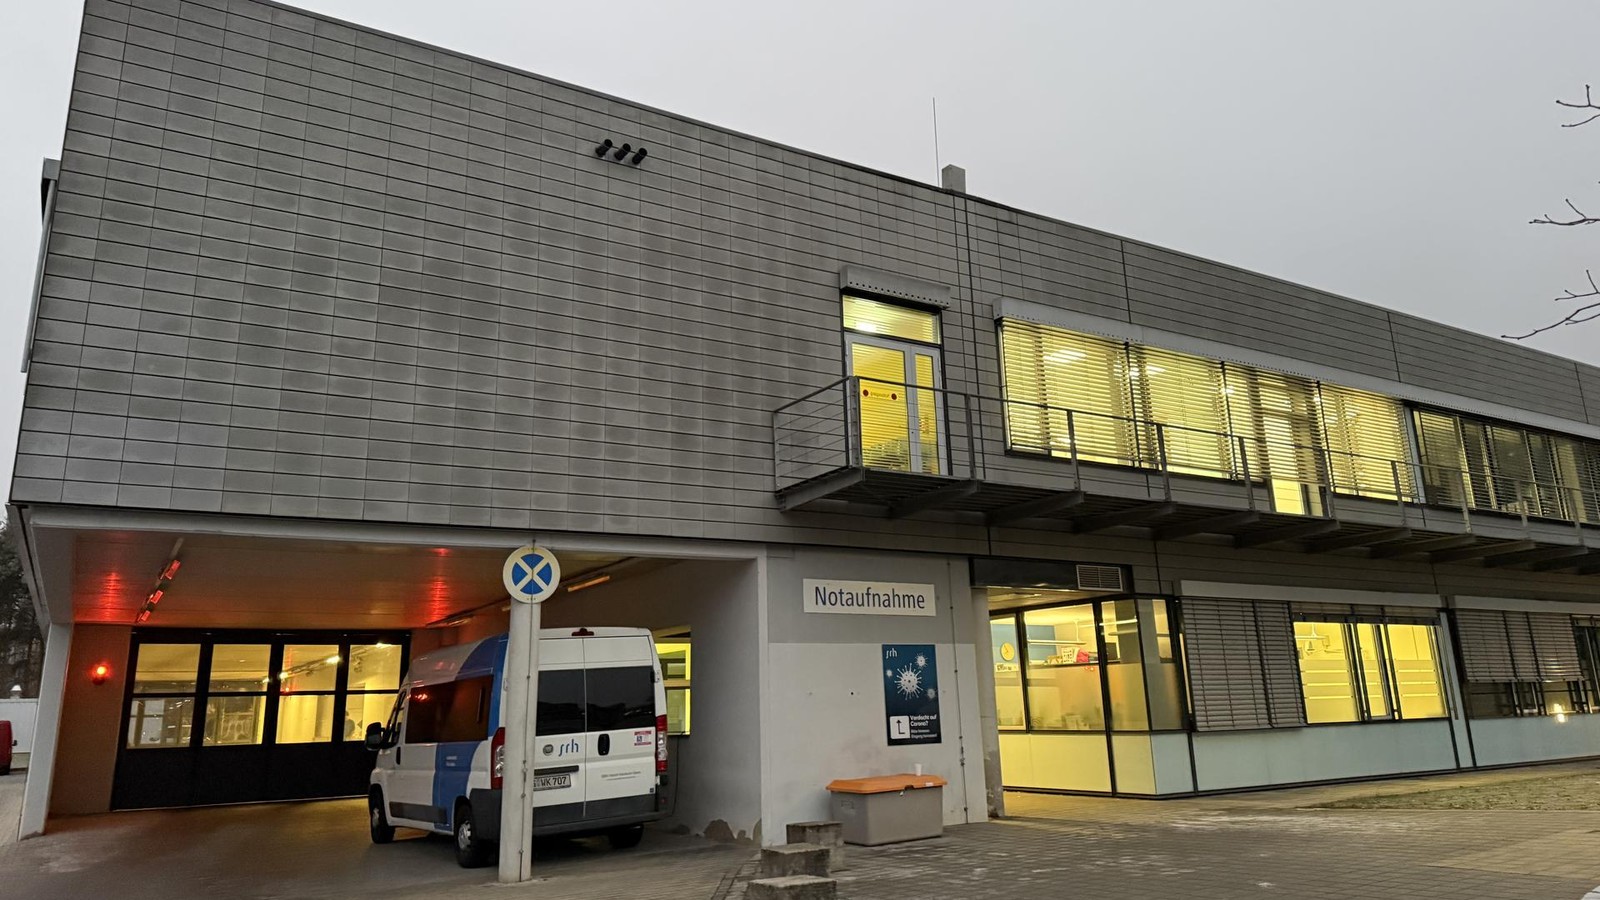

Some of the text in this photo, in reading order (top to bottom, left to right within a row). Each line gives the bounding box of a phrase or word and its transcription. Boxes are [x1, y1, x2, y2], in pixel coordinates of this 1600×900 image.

[815, 586, 925, 609] Notaufnahme
[886, 648, 898, 659] srh
[558, 739, 579, 757] srh
[552, 776, 567, 786] 707
